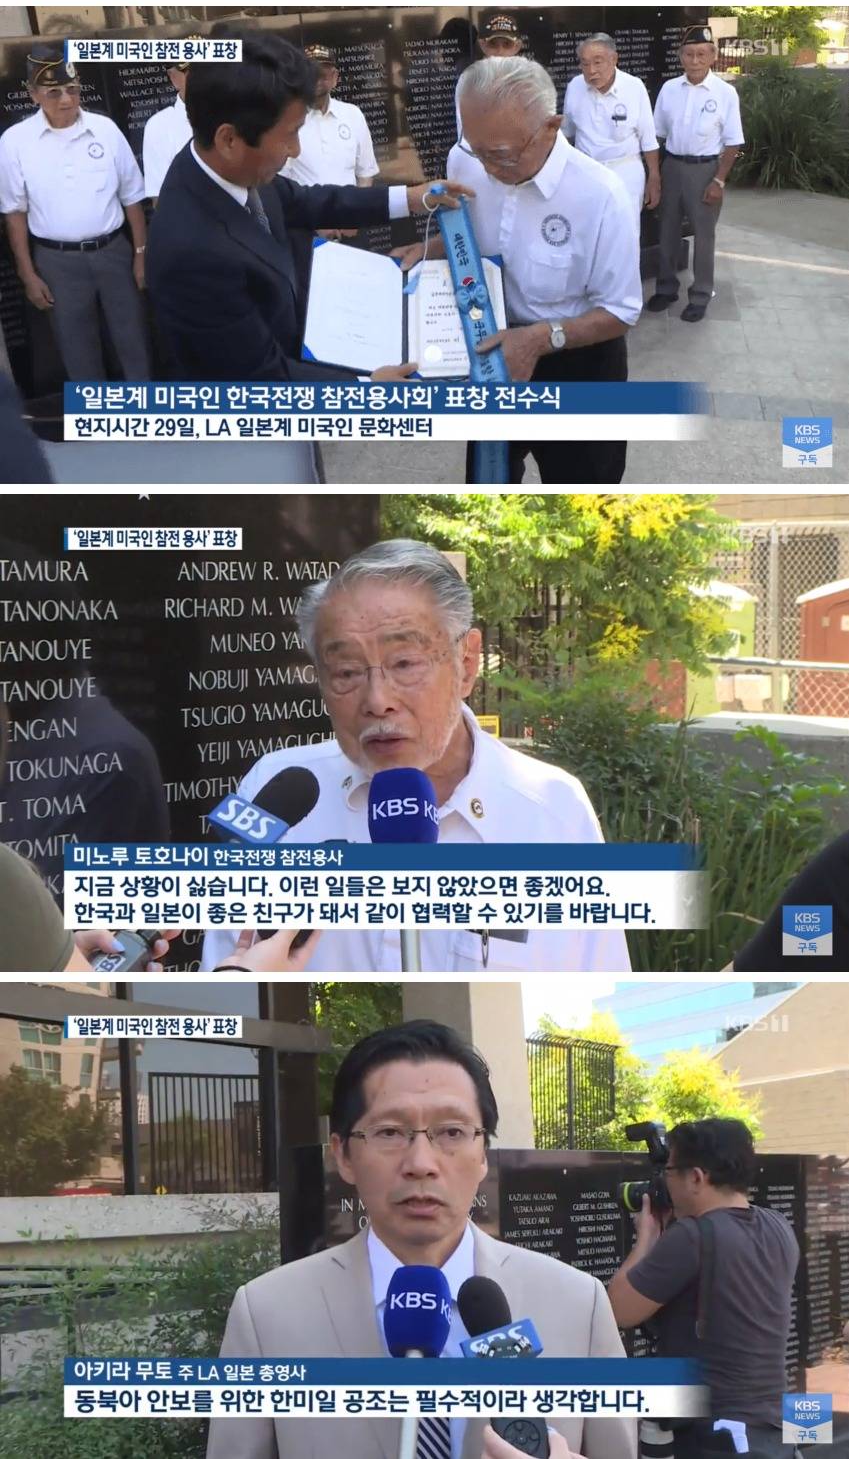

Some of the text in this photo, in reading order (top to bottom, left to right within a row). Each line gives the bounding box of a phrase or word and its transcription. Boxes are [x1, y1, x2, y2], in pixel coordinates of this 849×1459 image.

[0, 560, 89, 581] TAMURA
[1, 599, 118, 622] TANONAKA
[210, 632, 275, 654] MUNEO
[0, 677, 96, 702] TANOUYE
[188, 668, 249, 692] NOBUJI
[197, 740, 230, 765] YEIJI
[7, 752, 123, 782] TOKUNAGA
[23, 793, 87, 820] TOMA
[372, 797, 419, 820] KBS
[217, 799, 277, 839] SBS
[341, 1198, 354, 1212] IN
[390, 1292, 437, 1310] KBS
